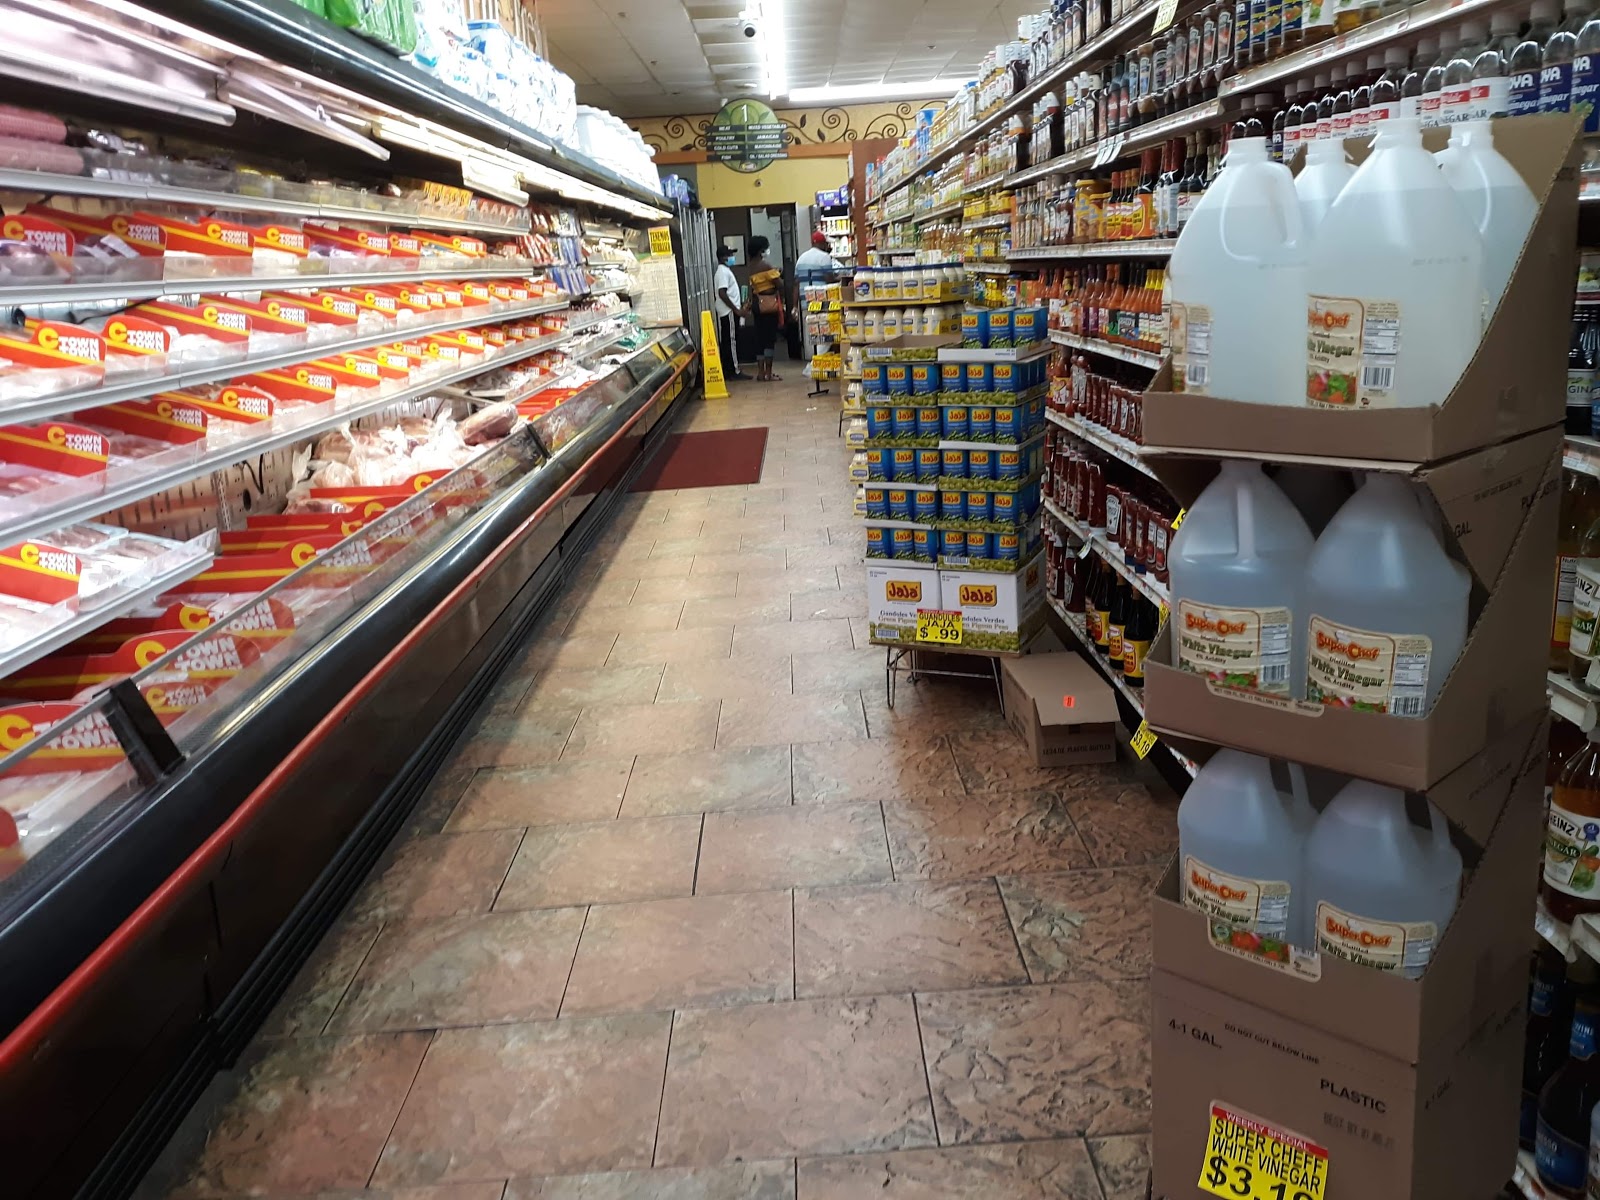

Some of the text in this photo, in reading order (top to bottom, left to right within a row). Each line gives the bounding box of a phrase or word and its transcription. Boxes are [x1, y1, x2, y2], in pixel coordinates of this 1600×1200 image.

[741, 104, 748, 122] 1
[38, 327, 58, 350] C
[919, 612, 960, 623] GUANDULES
[924, 620, 954, 630] JAJA
[1182, 636, 1254, 660] White Vinegar
[1311, 655, 1384, 687] White Vinegar
[1188, 889, 1250, 923] White Vinegar
[1320, 936, 1396, 971] White Vinegar
[1169, 1018, 1222, 1049] 4-1 GAL.
[1224, 1022, 1320, 1065] DO NOT CUT BELOW LINE
[1320, 1078, 1386, 1114] PLASTIC
[1215, 1118, 1323, 1174] SUPER CHEFF
[1226, 1112, 1308, 1149] WEEKLY SPECIAL
[1206, 1156, 1313, 1200] $3.1
[1212, 1134, 1321, 1194] WHITE VINEGAR
